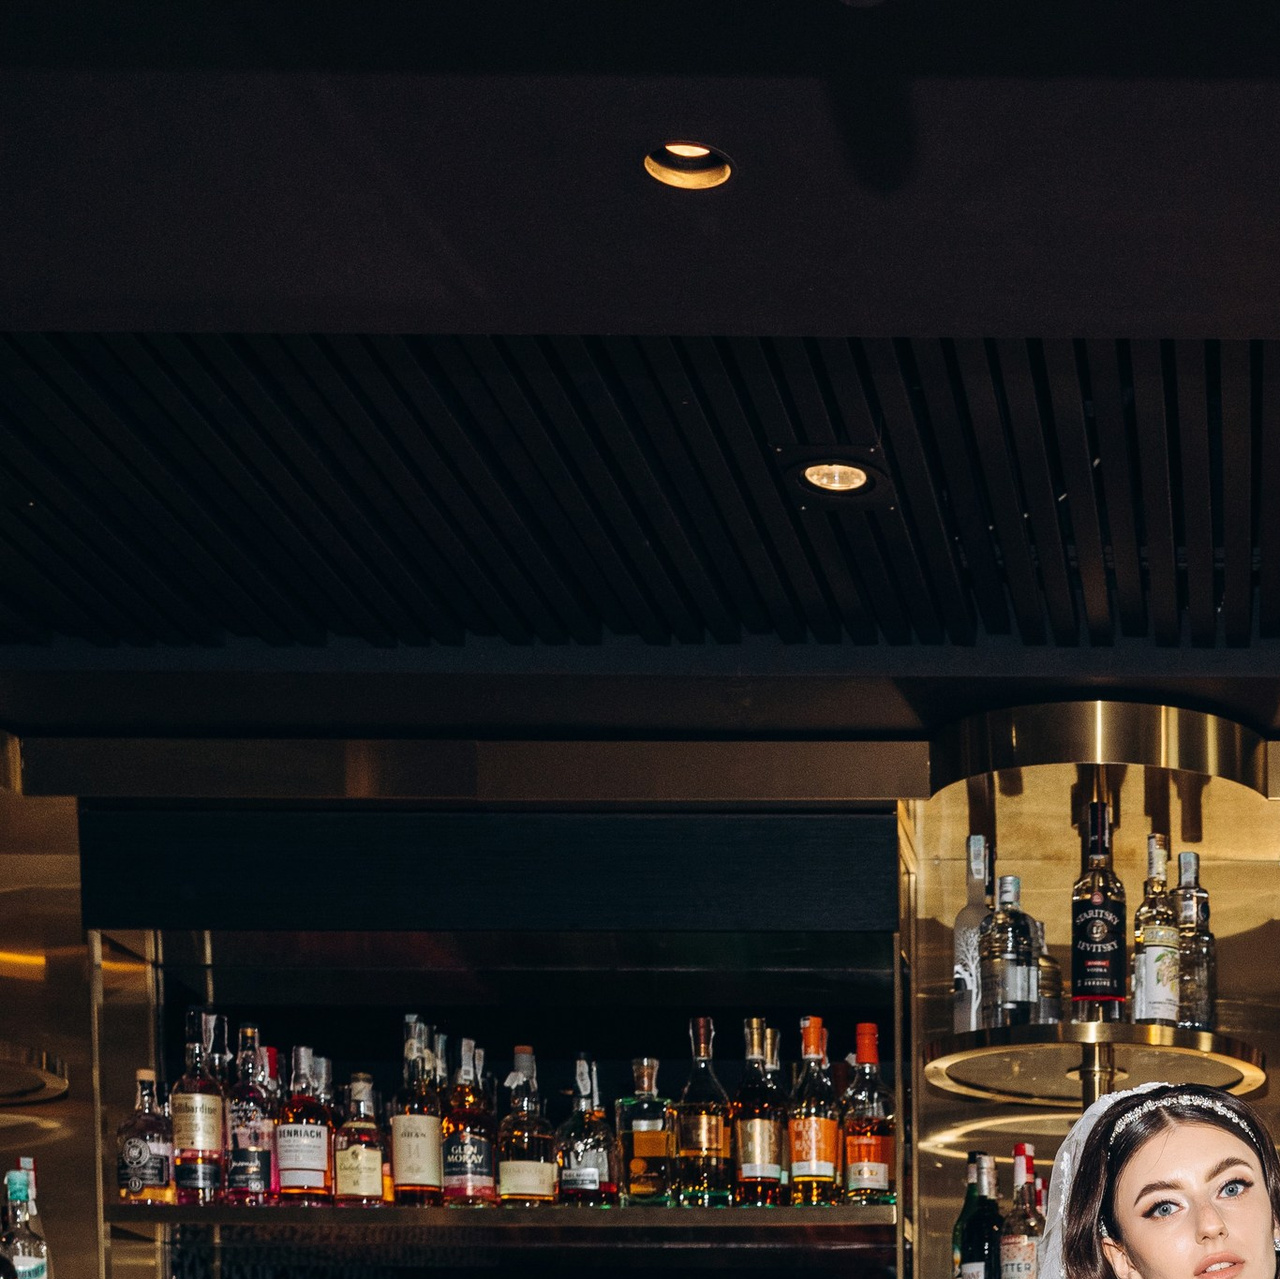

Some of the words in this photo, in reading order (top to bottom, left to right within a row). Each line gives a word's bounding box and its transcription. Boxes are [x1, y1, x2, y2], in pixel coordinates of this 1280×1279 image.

[1076, 909, 1119, 925] STARITSKY
[1077, 941, 1118, 952] LEVITSKY
[447, 1154, 483, 1164] MORAY
[1003, 1263, 1031, 1272] TTER
